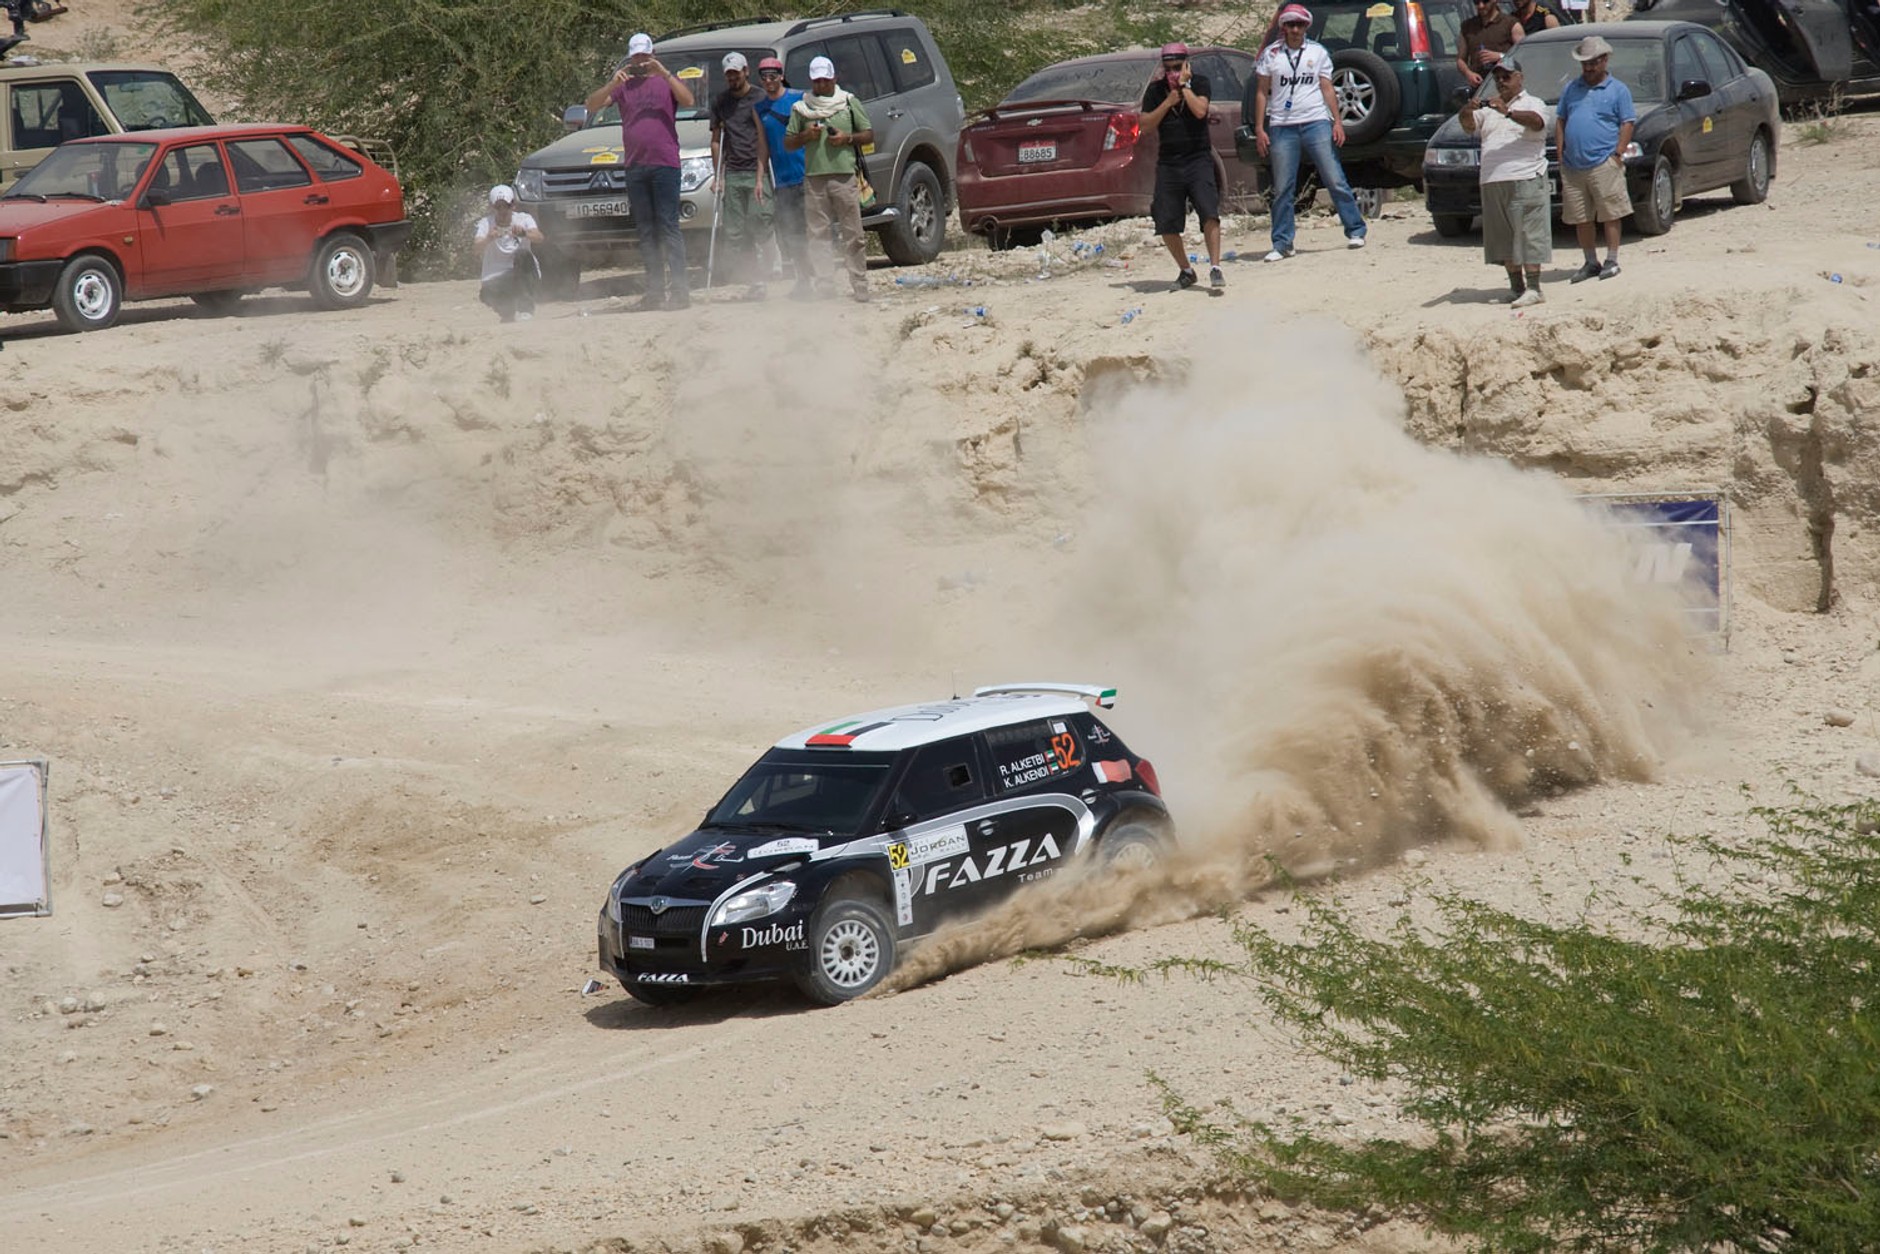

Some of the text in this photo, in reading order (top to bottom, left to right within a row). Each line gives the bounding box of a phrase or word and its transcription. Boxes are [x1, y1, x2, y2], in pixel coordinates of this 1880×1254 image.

[1280, 73, 1314, 87] bwin
[1051, 732, 1081, 769] 52
[1011, 753, 1045, 772] ALKETBI
[1014, 765, 1049, 787] ALKENDI
[911, 834, 965, 855] JORDAN
[889, 842, 910, 869] 52
[925, 832, 1062, 895] FAZZA
[1017, 868, 1054, 883] Team
[741, 920, 804, 949] Dubai
[637, 973, 688, 982] FAZZA
